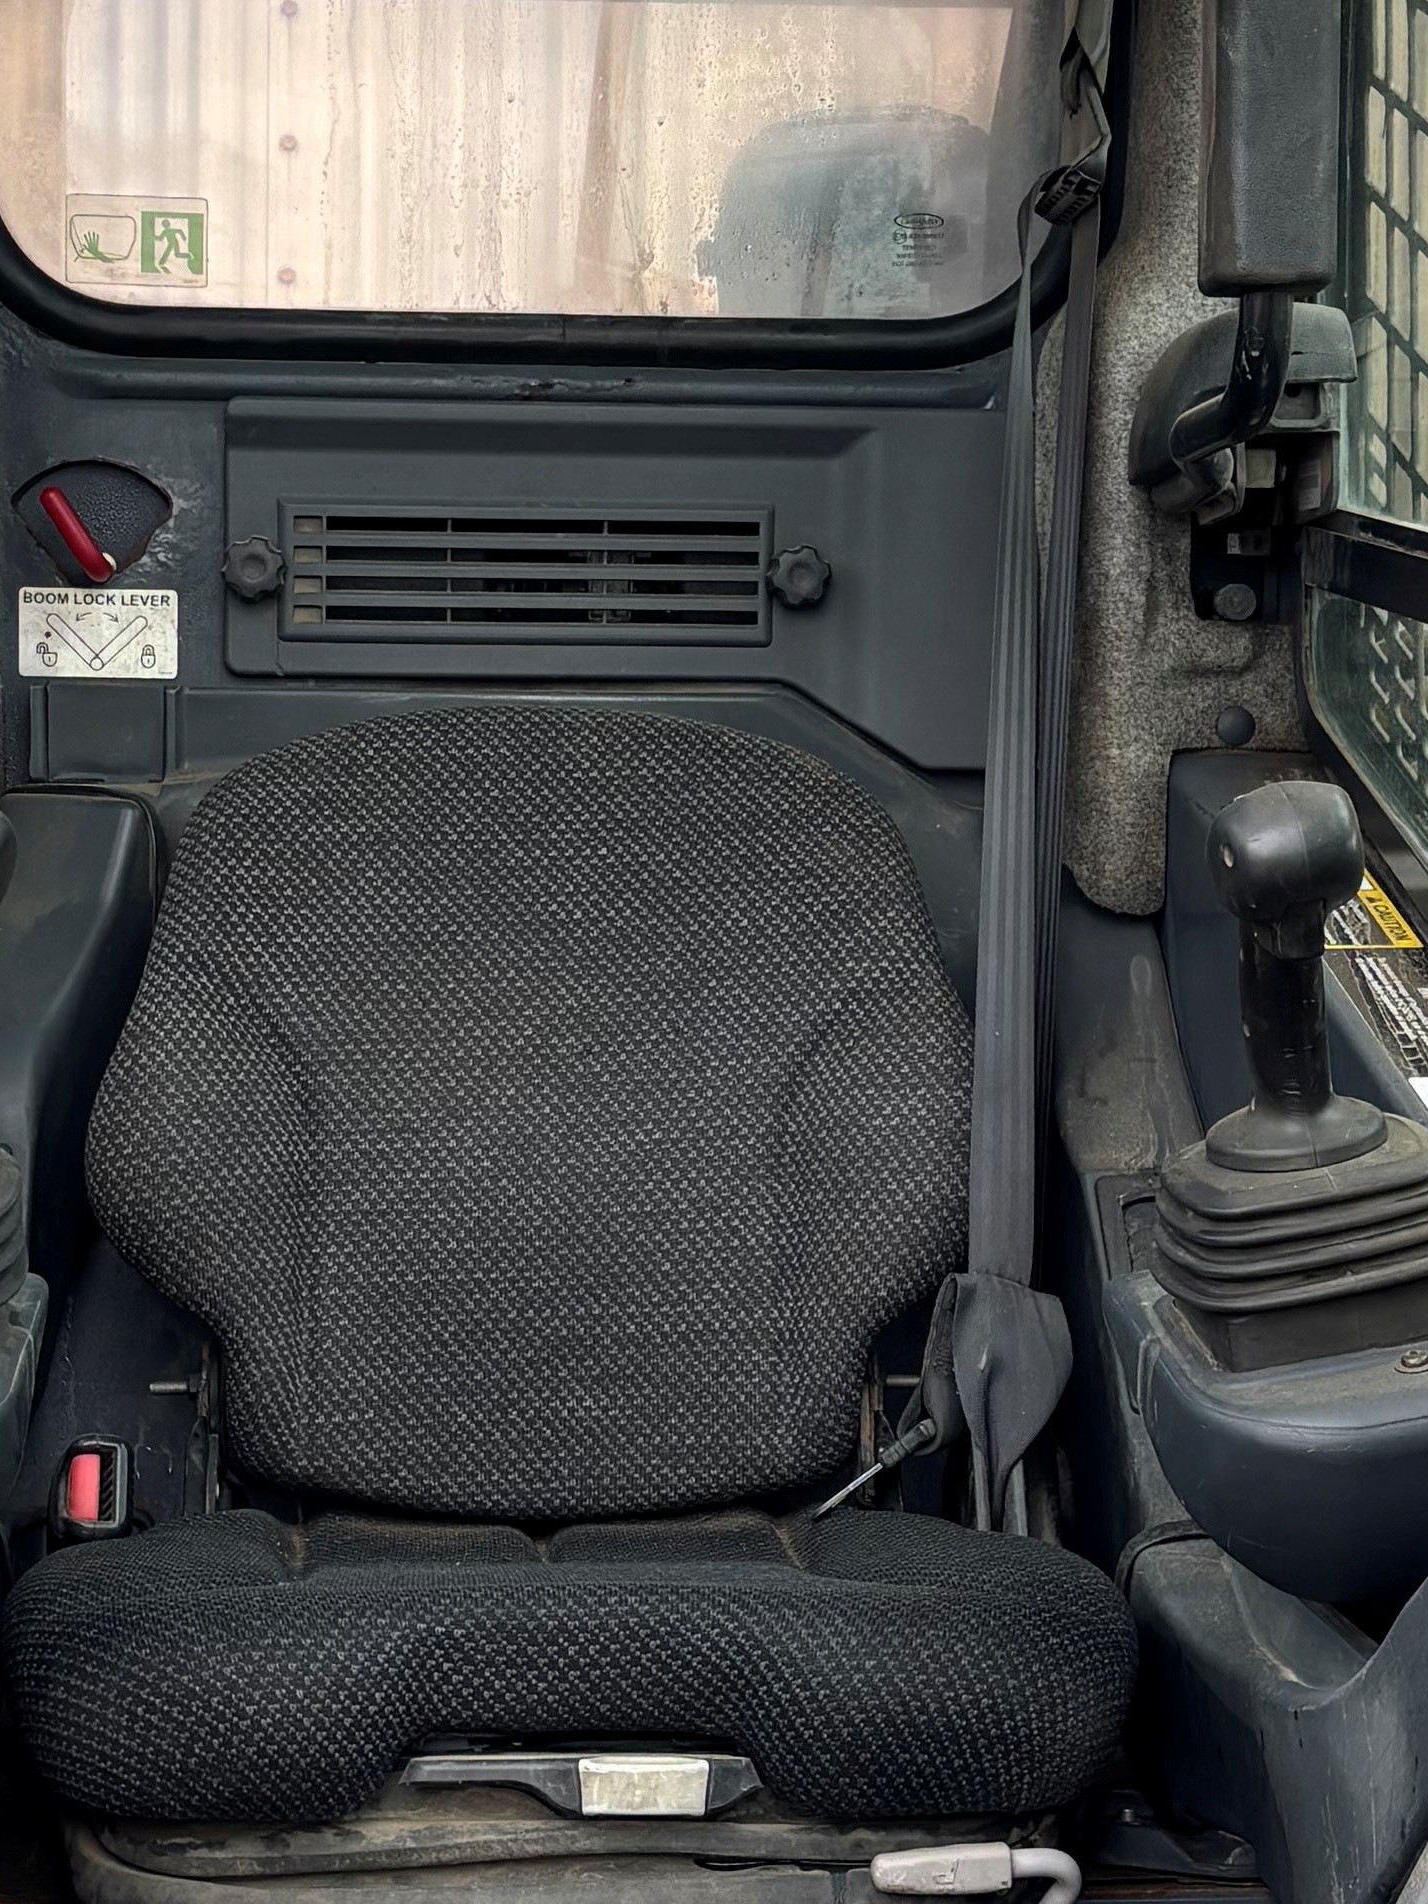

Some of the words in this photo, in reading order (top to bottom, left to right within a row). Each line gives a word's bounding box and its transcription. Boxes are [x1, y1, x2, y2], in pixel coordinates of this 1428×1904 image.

[23, 591, 69, 604] BOOM
[74, 593, 116, 605] LOCK
[121, 594, 171, 606] LEVER
